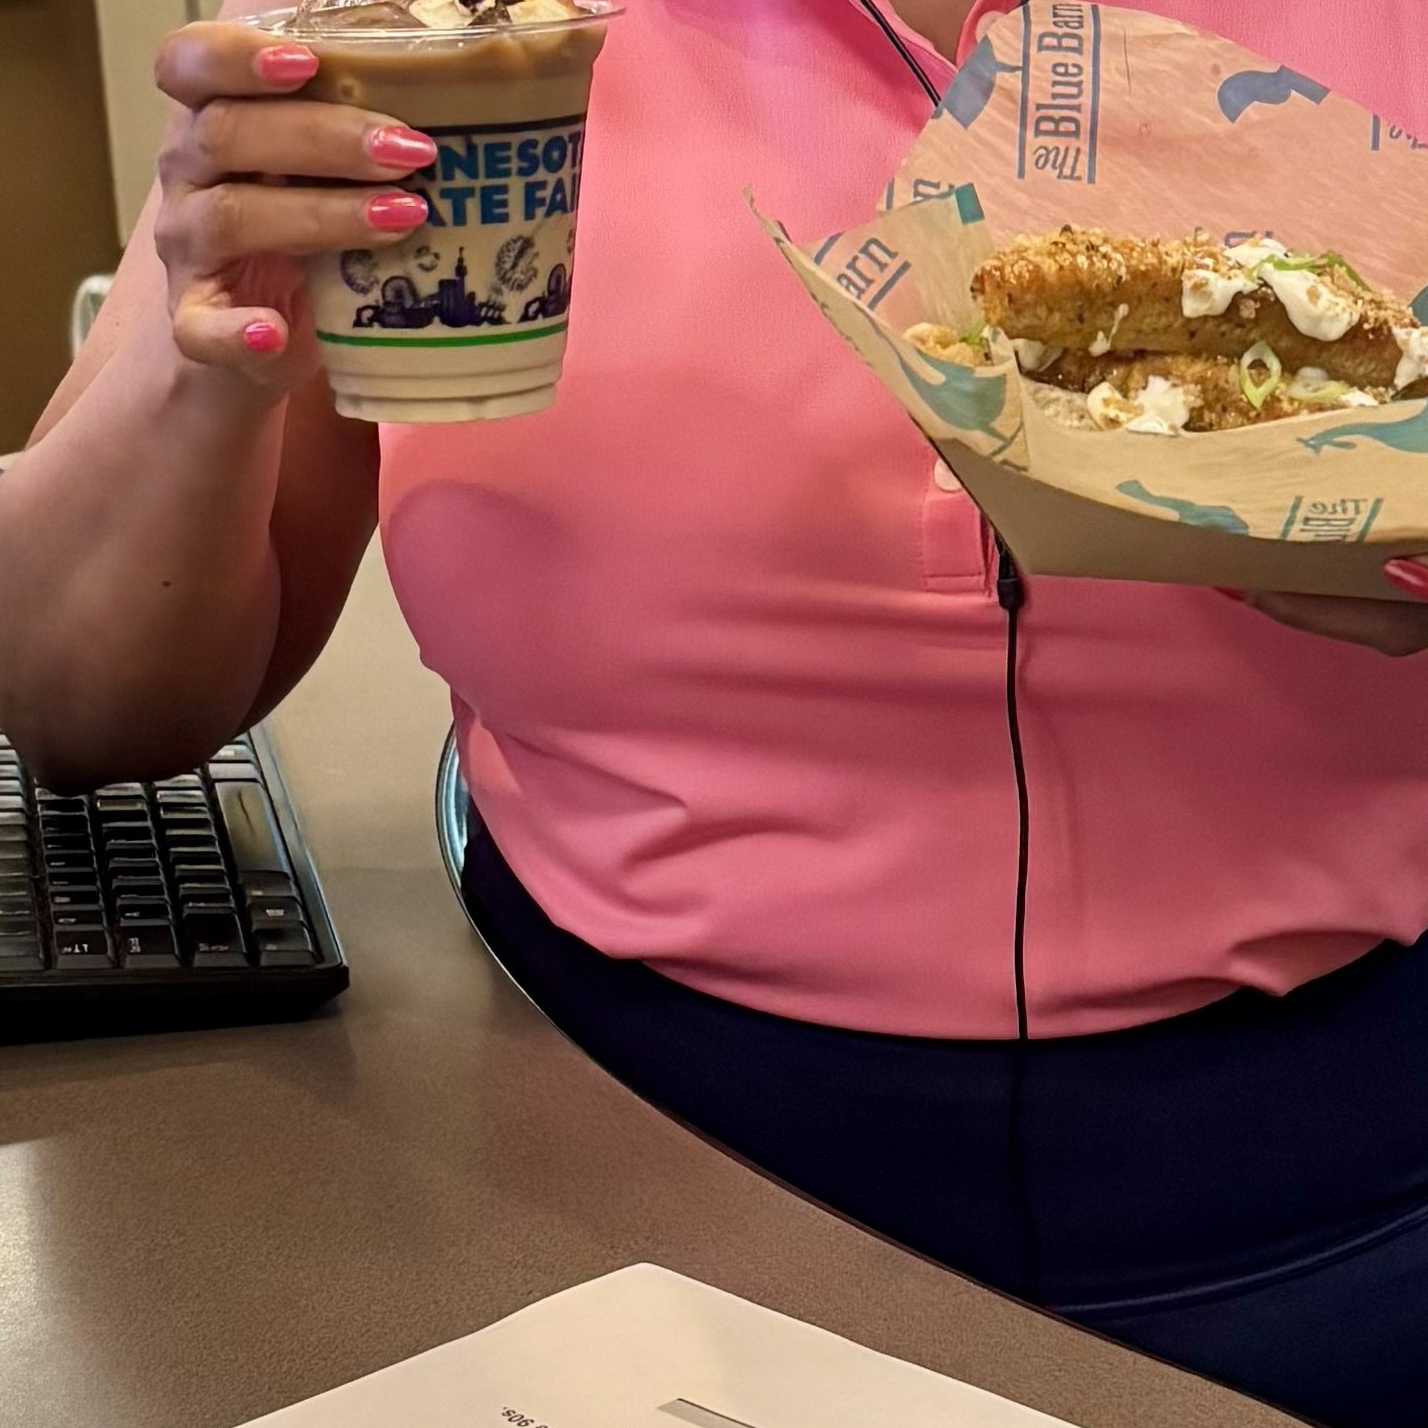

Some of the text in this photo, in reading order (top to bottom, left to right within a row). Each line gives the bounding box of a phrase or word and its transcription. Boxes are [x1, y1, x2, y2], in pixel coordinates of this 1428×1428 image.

[1033, 2, 1085, 182] The Blue Barn
[416, 130, 582, 182] NESOT
[491, 1406, 537, 1427] 90s.
